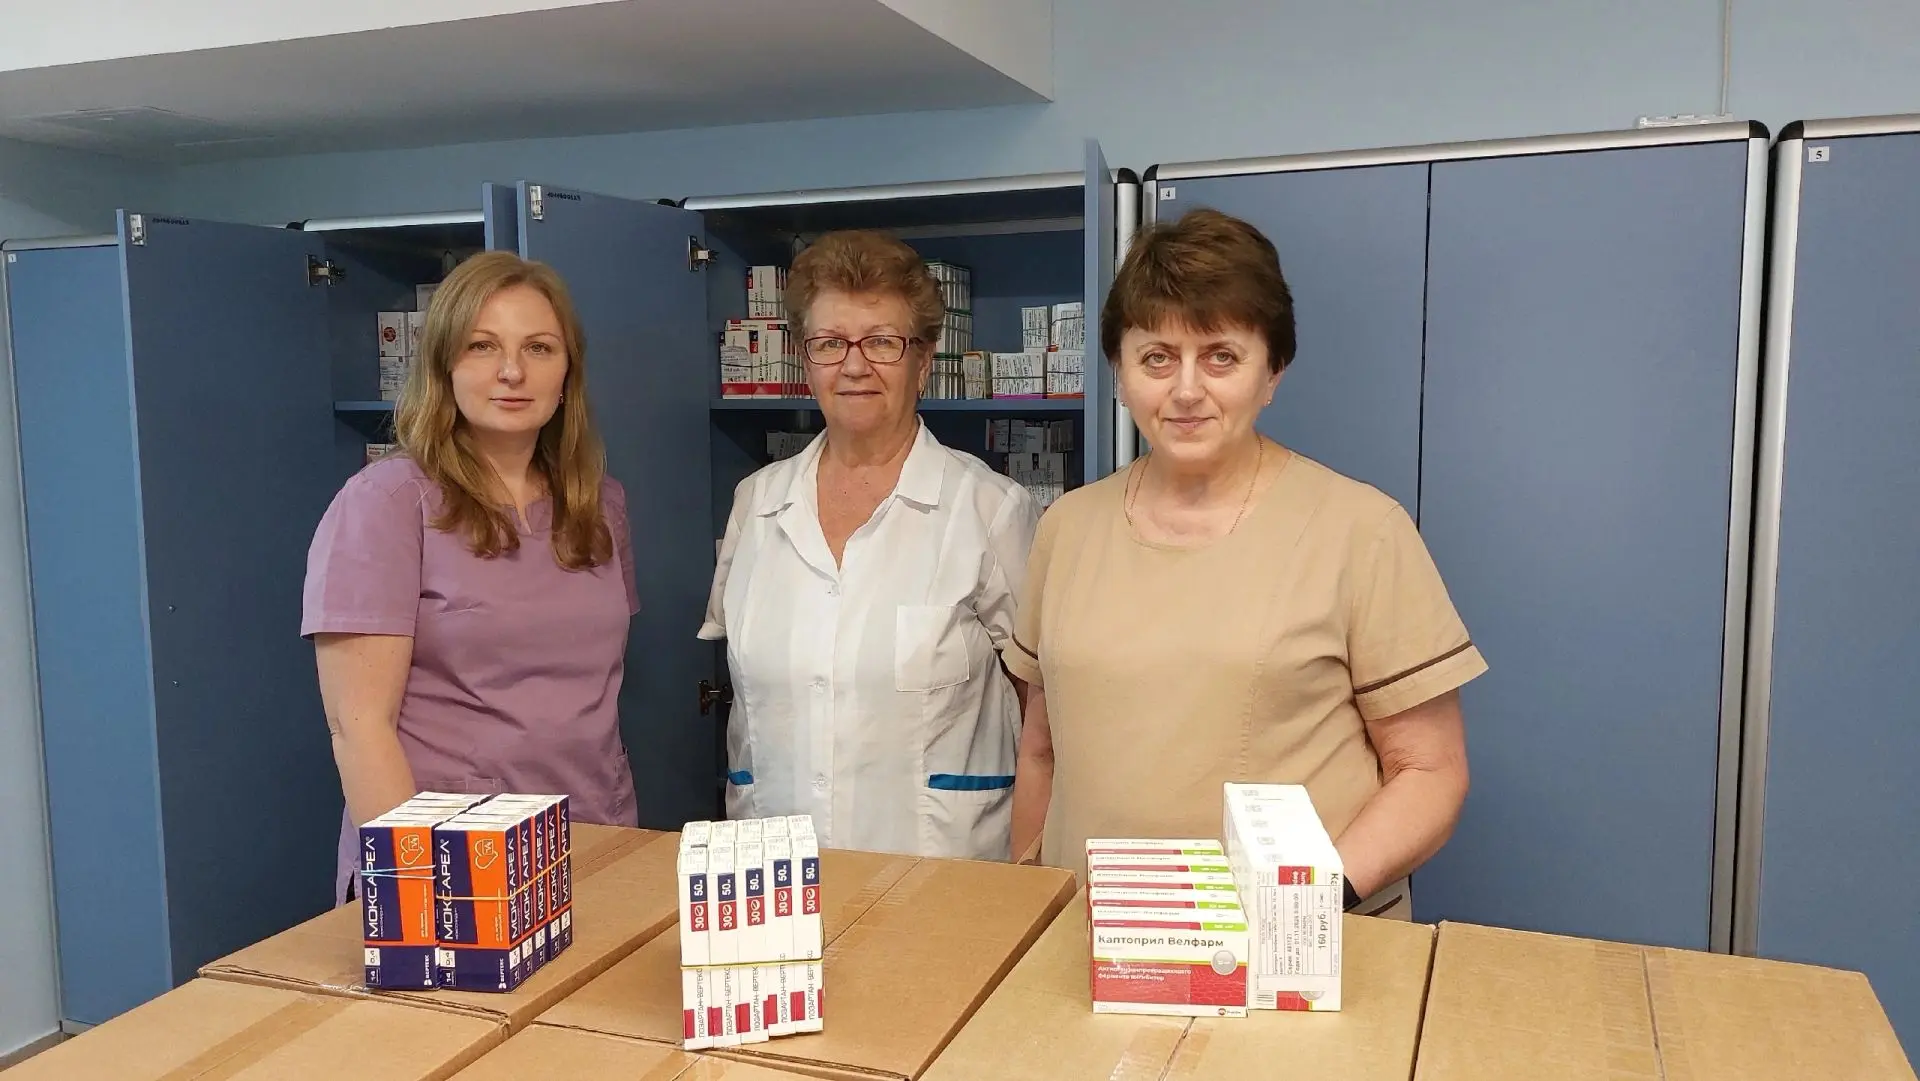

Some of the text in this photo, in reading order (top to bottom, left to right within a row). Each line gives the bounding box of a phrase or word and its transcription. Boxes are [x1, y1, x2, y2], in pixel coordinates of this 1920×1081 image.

[1816, 150, 1822, 160] 5
[778, 868, 787, 882] 50
[806, 866, 815, 879] 50
[694, 884, 702, 896] 50
[722, 882, 731, 896] 50
[750, 878, 759, 890] 50
[778, 901, 787, 914] 30
[806, 899, 815, 911] 30
[695, 916, 704, 928] 30
[723, 915, 732, 928] 30
[751, 910, 760, 923] 30
[1317, 911, 1328, 931] руб.
[1098, 934, 1224, 949] Каптоприл Велфарм
[1318, 934, 1326, 950] 160
[752, 966, 760, 1031] ЛОЗАРТАН-ВЕРТЕК
